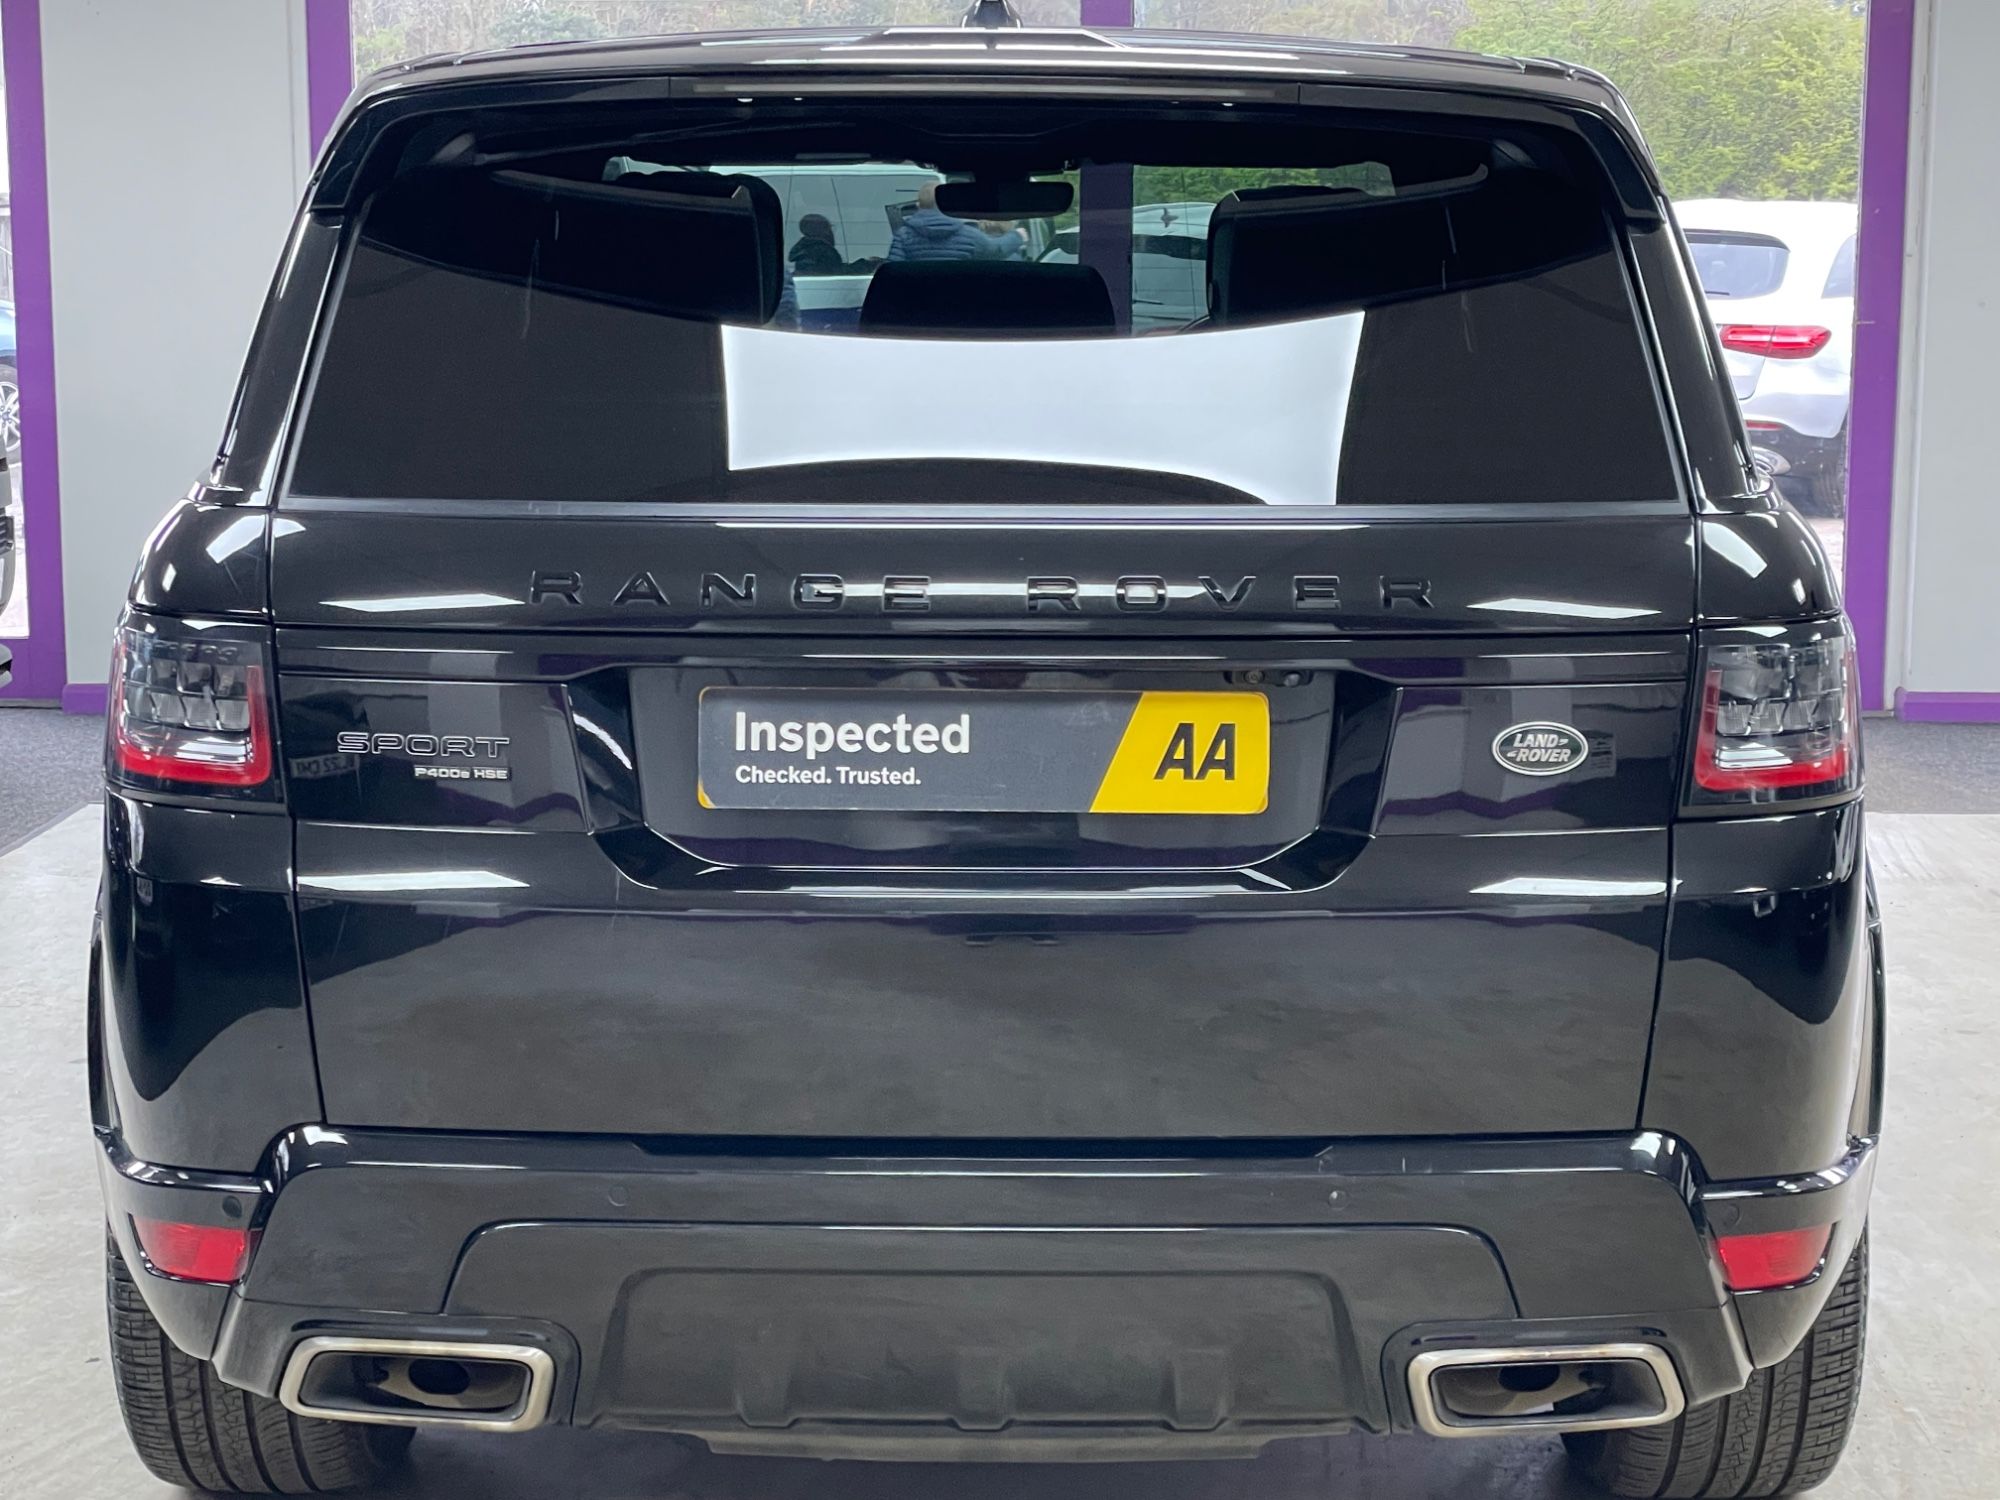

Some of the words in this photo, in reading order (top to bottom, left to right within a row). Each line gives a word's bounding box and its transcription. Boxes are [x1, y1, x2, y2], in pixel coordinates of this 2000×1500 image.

[529, 570, 932, 613] RANGE
[1026, 574, 1436, 613] ROVER
[337, 731, 510, 758] SPORT
[735, 711, 970, 759] Inspected
[1513, 733, 1559, 748] LAND
[1153, 722, 1237, 781] AA
[1516, 748, 1571, 762] ROVER
[414, 766, 470, 779] P400e
[474, 767, 508, 780] HSE
[735, 765, 832, 785] Checked.
[836, 766, 922, 786] Trusted.
